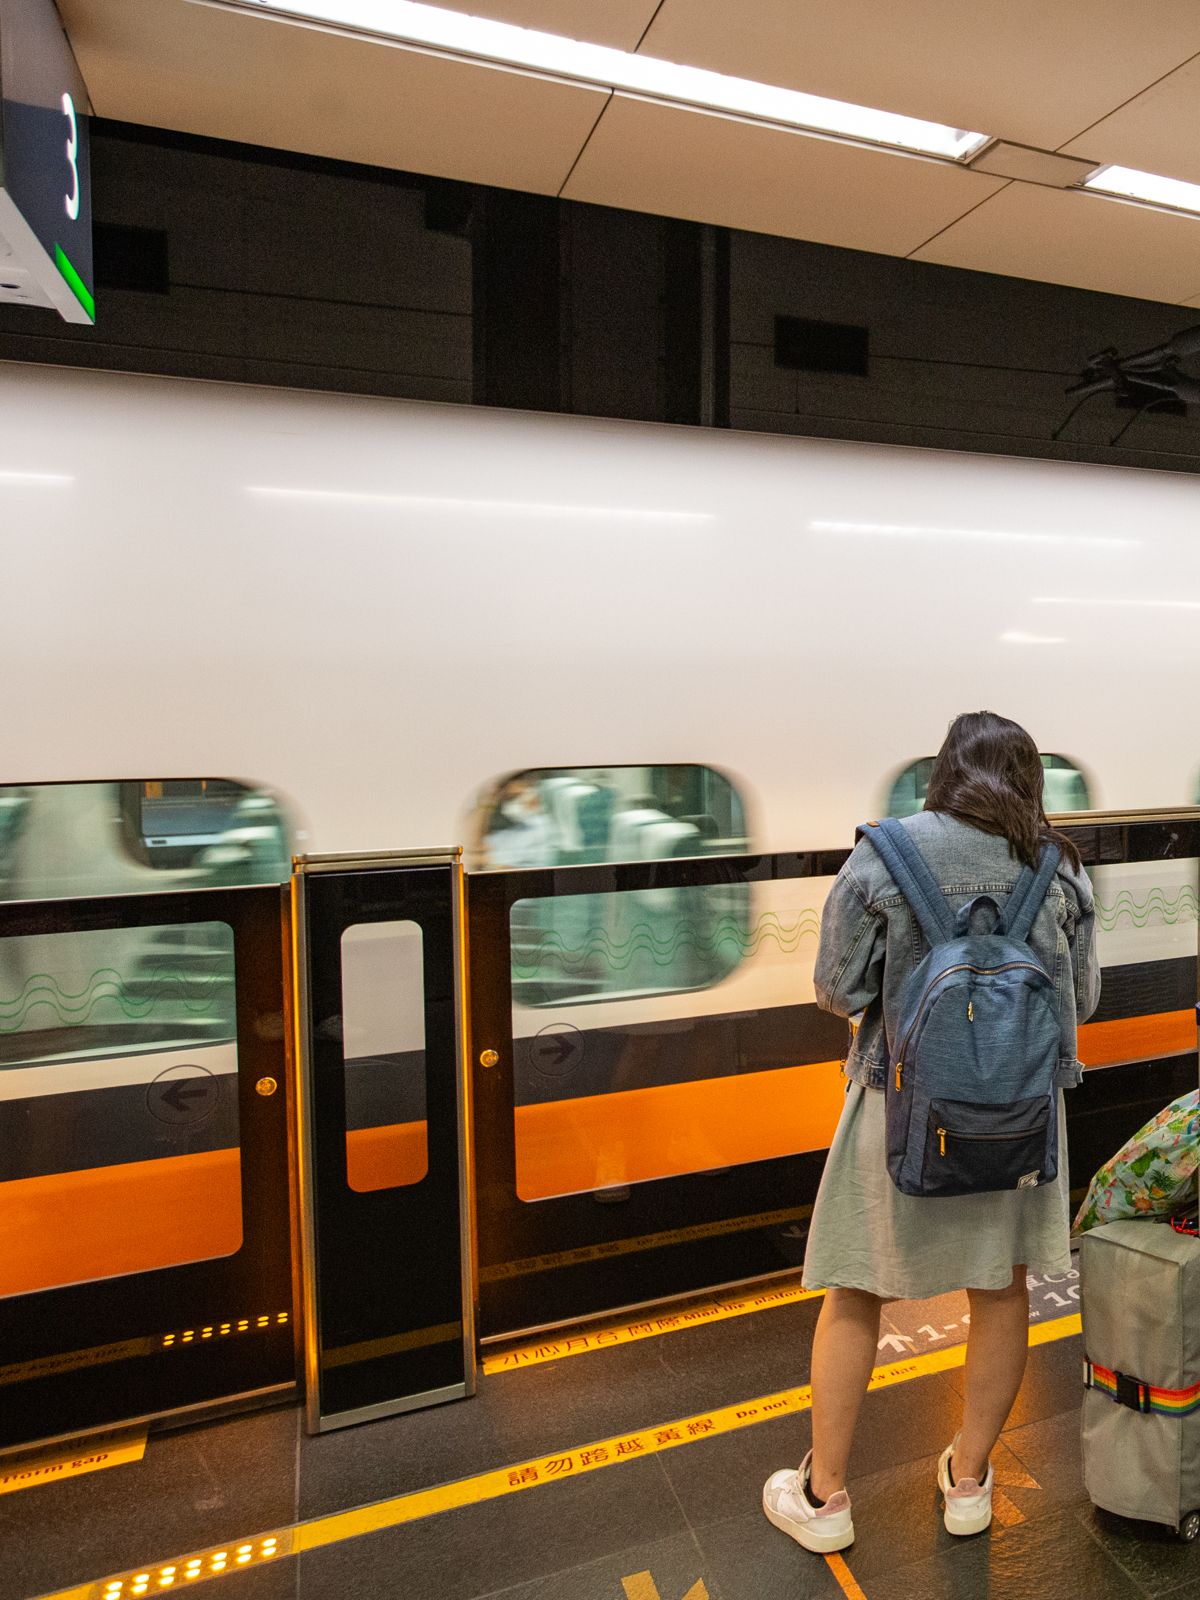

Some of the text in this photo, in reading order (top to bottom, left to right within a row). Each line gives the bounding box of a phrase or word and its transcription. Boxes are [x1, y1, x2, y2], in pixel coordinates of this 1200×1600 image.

[61, 92, 80, 221] 3
[683, 1307, 720, 1322] Mind
[735, 1408, 758, 1419] Do
[763, 1399, 790, 1412] not
[71, 1452, 109, 1469] gap
